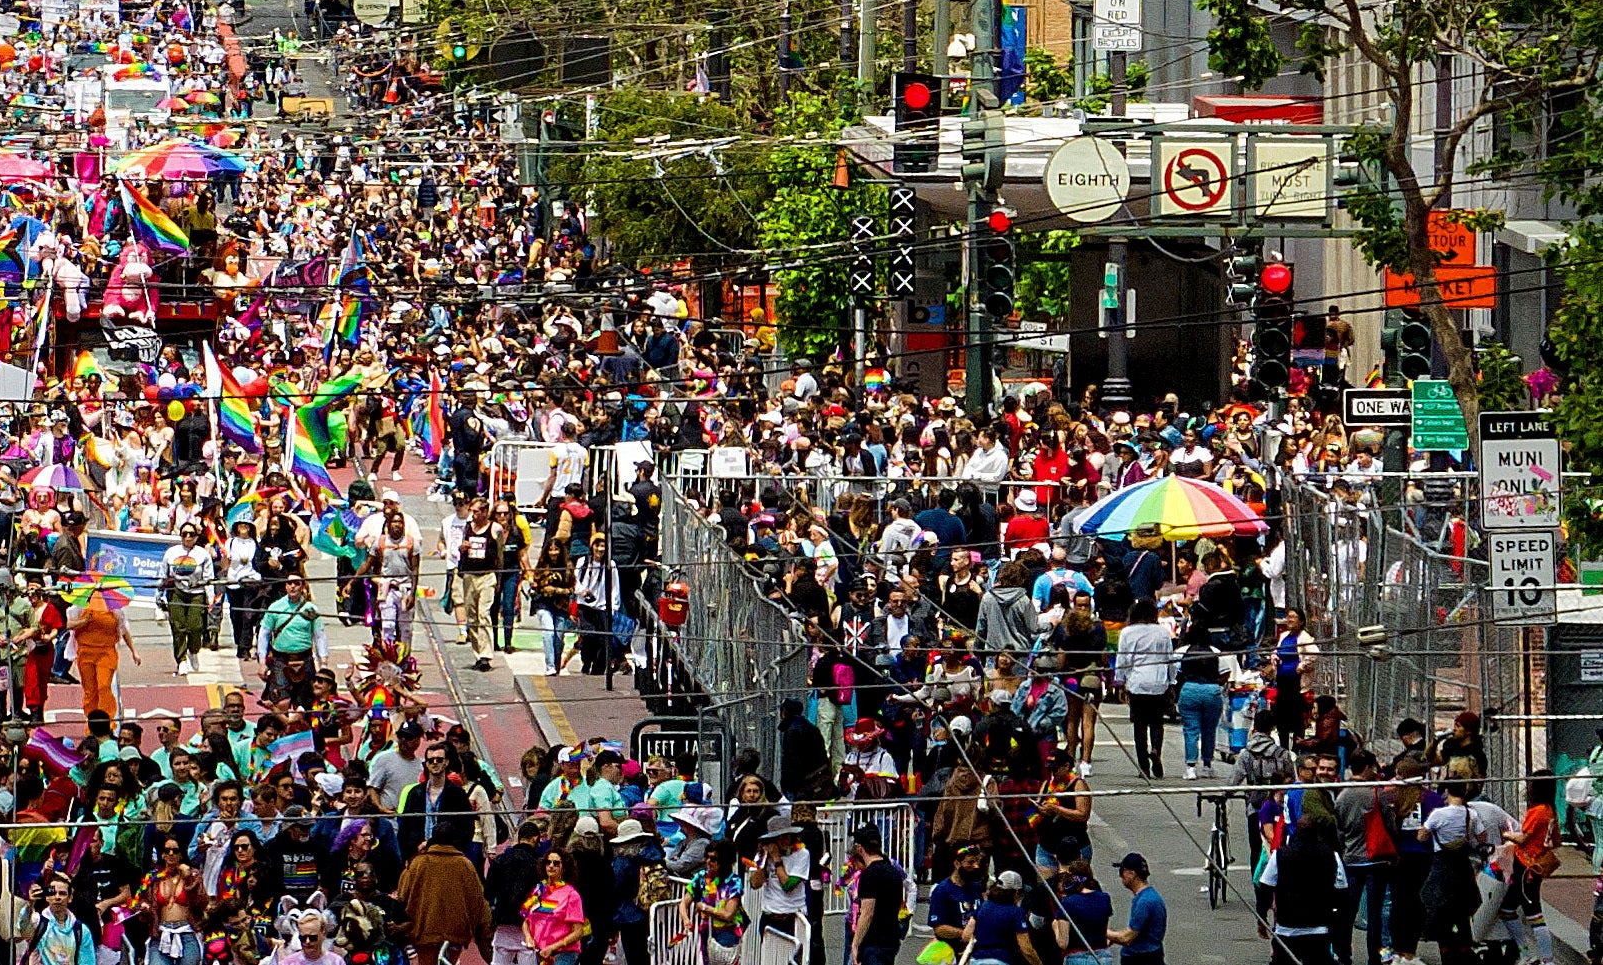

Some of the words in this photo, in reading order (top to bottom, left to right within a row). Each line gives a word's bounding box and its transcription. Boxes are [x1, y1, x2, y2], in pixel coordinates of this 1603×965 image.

[1108, 11, 1128, 19] RED
[1058, 173, 1119, 186] EIGHTH
[1272, 175, 1311, 188] MUST
[1430, 235, 1466, 247] TOUR
[1404, 281, 1473, 295] MKET
[1357, 401, 1384, 414] ONE
[1390, 401, 1412, 414] WA
[1489, 422, 1515, 433] LEFT
[1520, 421, 1550, 432] LANE
[562, 457, 582, 475] 21
[1498, 452, 1543, 467] MUNI
[1495, 540, 1549, 553] SPEED
[1501, 558, 1544, 571] LIMIT
[1504, 576, 1543, 607] 10
[647, 739, 675, 756] LEFT
[685, 739, 717, 756] LAE
